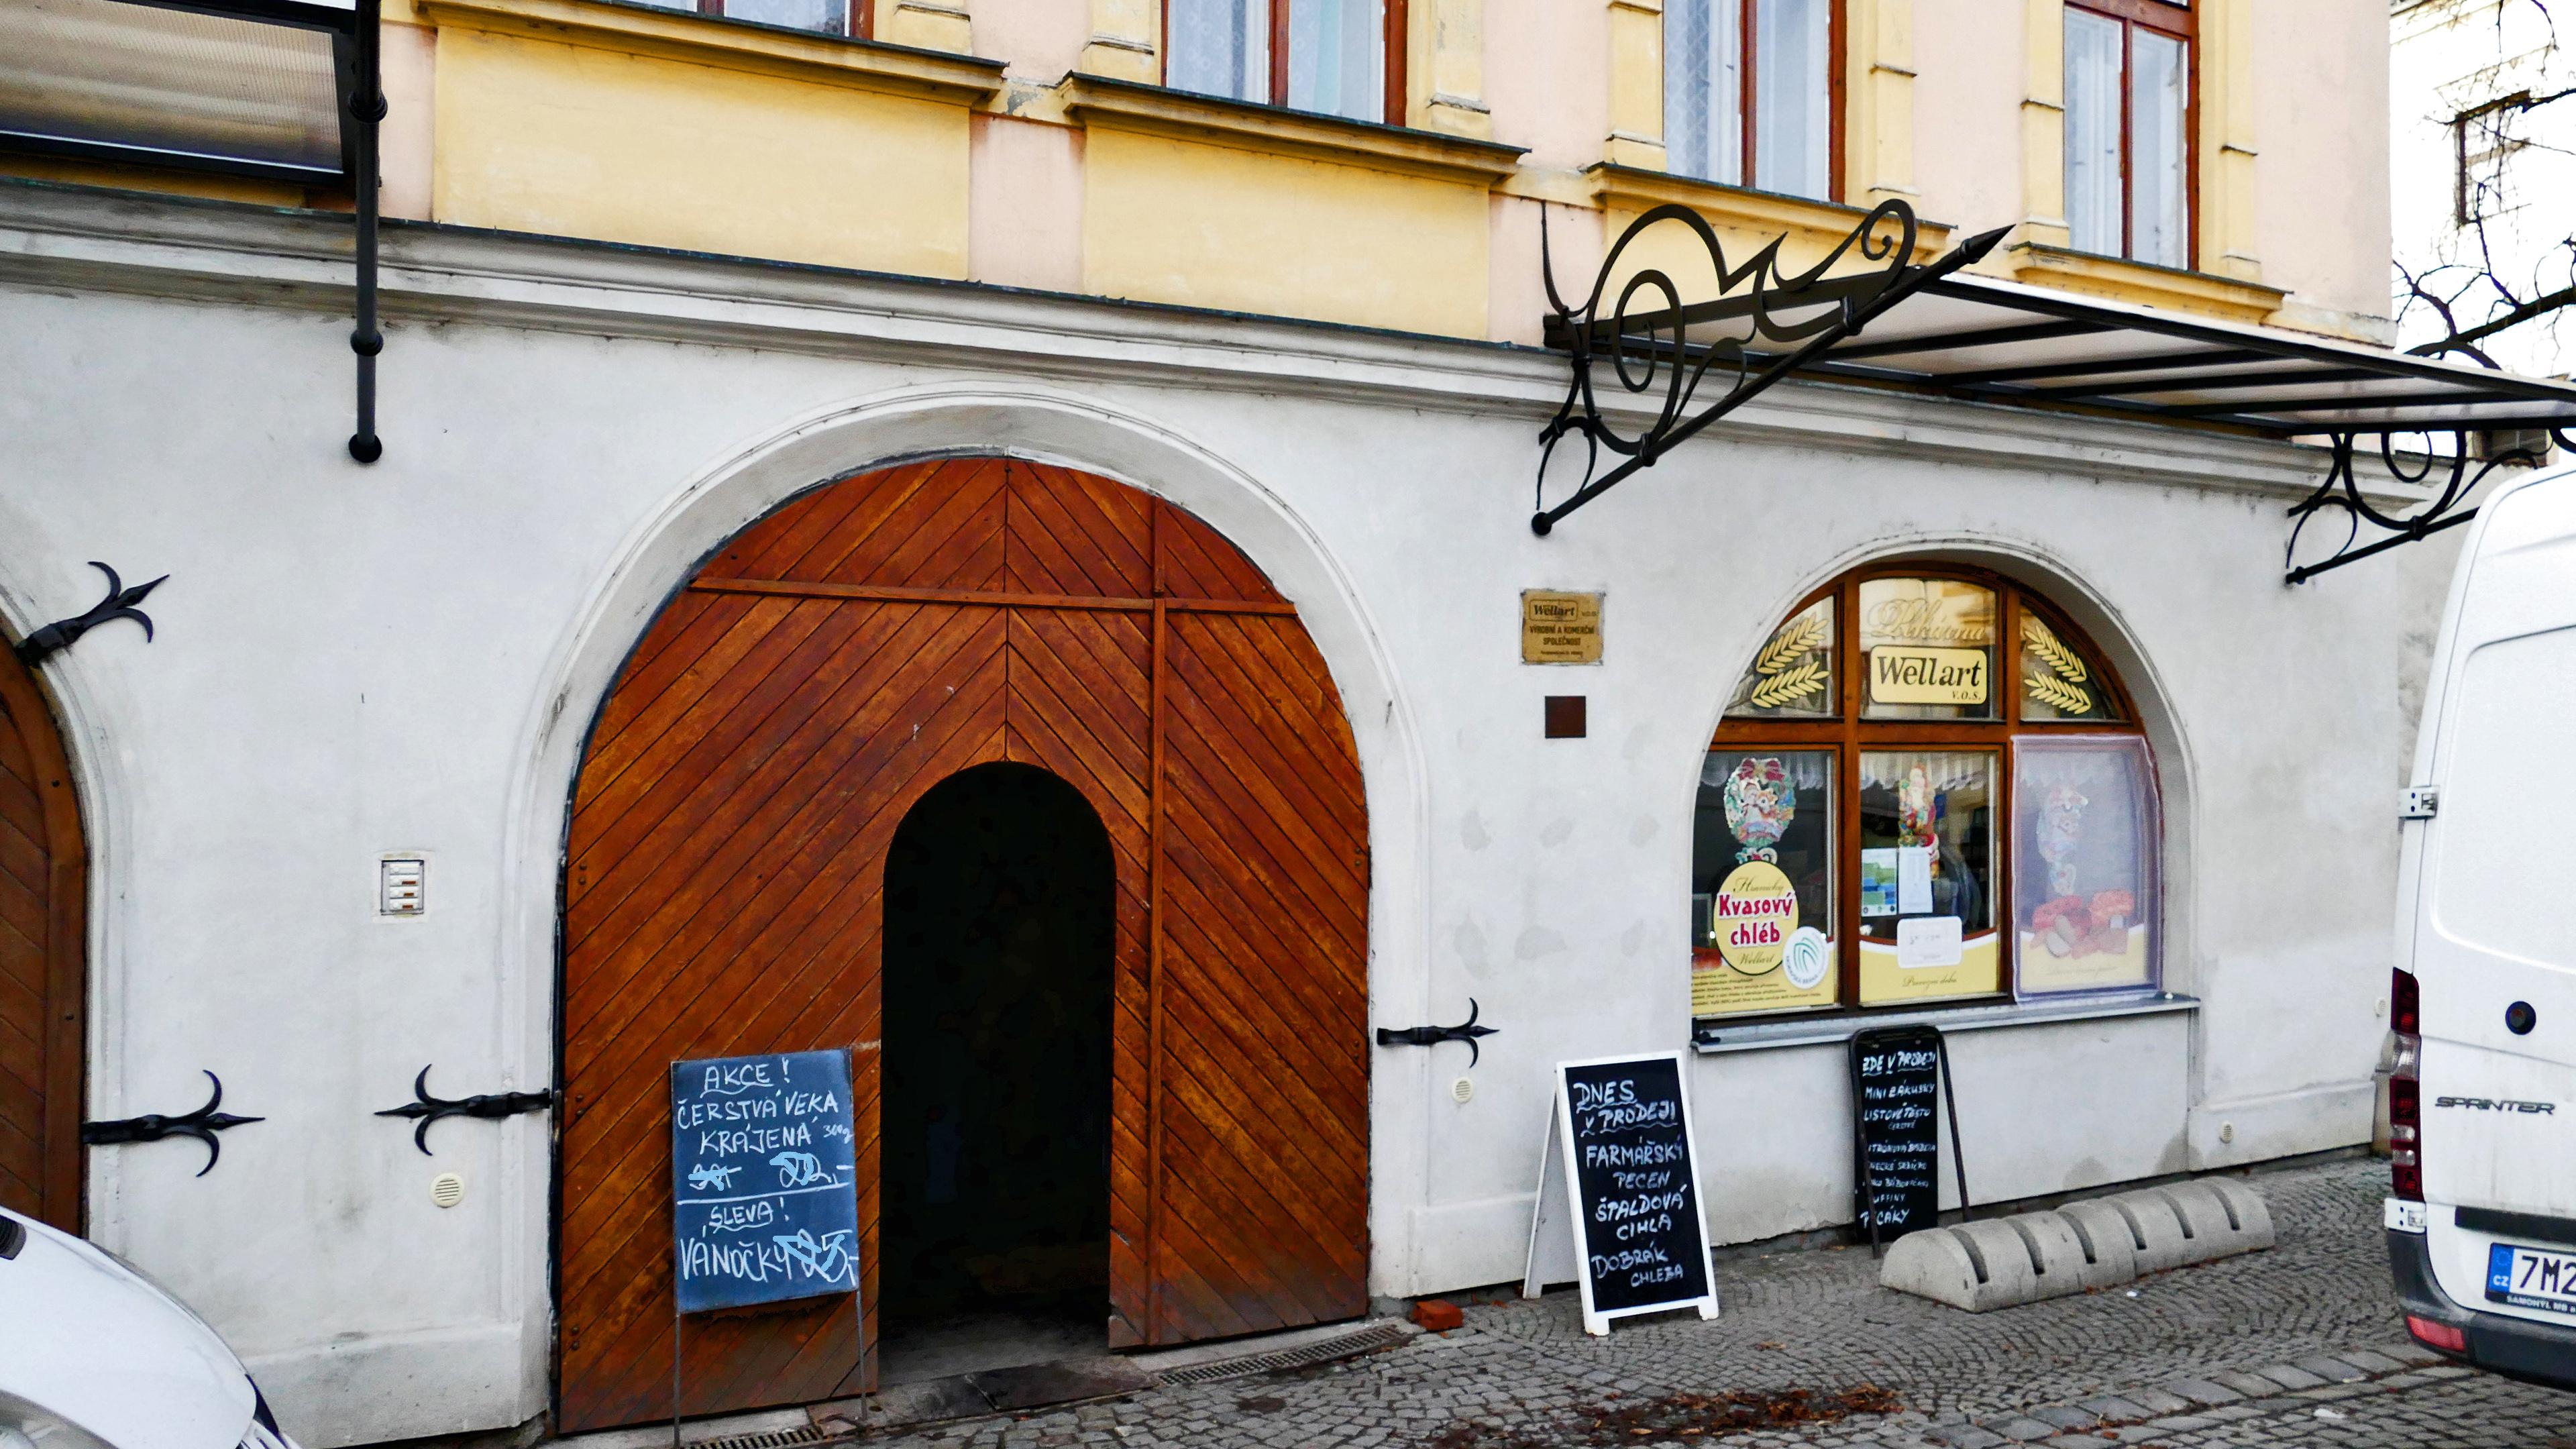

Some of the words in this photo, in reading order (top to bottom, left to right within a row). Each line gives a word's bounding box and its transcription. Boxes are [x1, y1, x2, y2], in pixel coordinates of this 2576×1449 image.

[1534, 604, 1574, 616] Wellart
[1877, 656, 1982, 687] Wellart
[1719, 892, 1792, 916] Kvasový
[1731, 922, 1780, 945] chléb
[1862, 1055, 1884, 1072] ZDE
[704, 1063, 771, 1091] AKCE
[1865, 1086, 1886, 1099] MINI
[1888, 1079, 1935, 1097] ZÁKUSKY
[1573, 1080, 1635, 1107] DNES
[2435, 1096, 2555, 1115] SPRINTER
[678, 1089, 782, 1129] ČERSTVÁ
[786, 1090, 839, 1116] VEKA
[1598, 1099, 1676, 1129] PRODEJI
[699, 1116, 818, 1157] KRÁJENÁ
[1586, 1134, 1683, 1169] FARMÁŘSKÝ
[1595, 1183, 1688, 1222] ŠPALDOVÁ
[1869, 1193, 1905, 1204] UFFINY
[709, 1201, 773, 1225] SLEVA
[1616, 1214, 1672, 1240] CIHLA
[680, 1225, 792, 1283] VÁNOČKY
[1591, 1240, 1668, 1279] DOBRÁK
[1631, 1264, 1683, 1287] CHLEBA
[2493, 1275, 2509, 1287] CZ
[2520, 1255, 2576, 1296] 7M2
